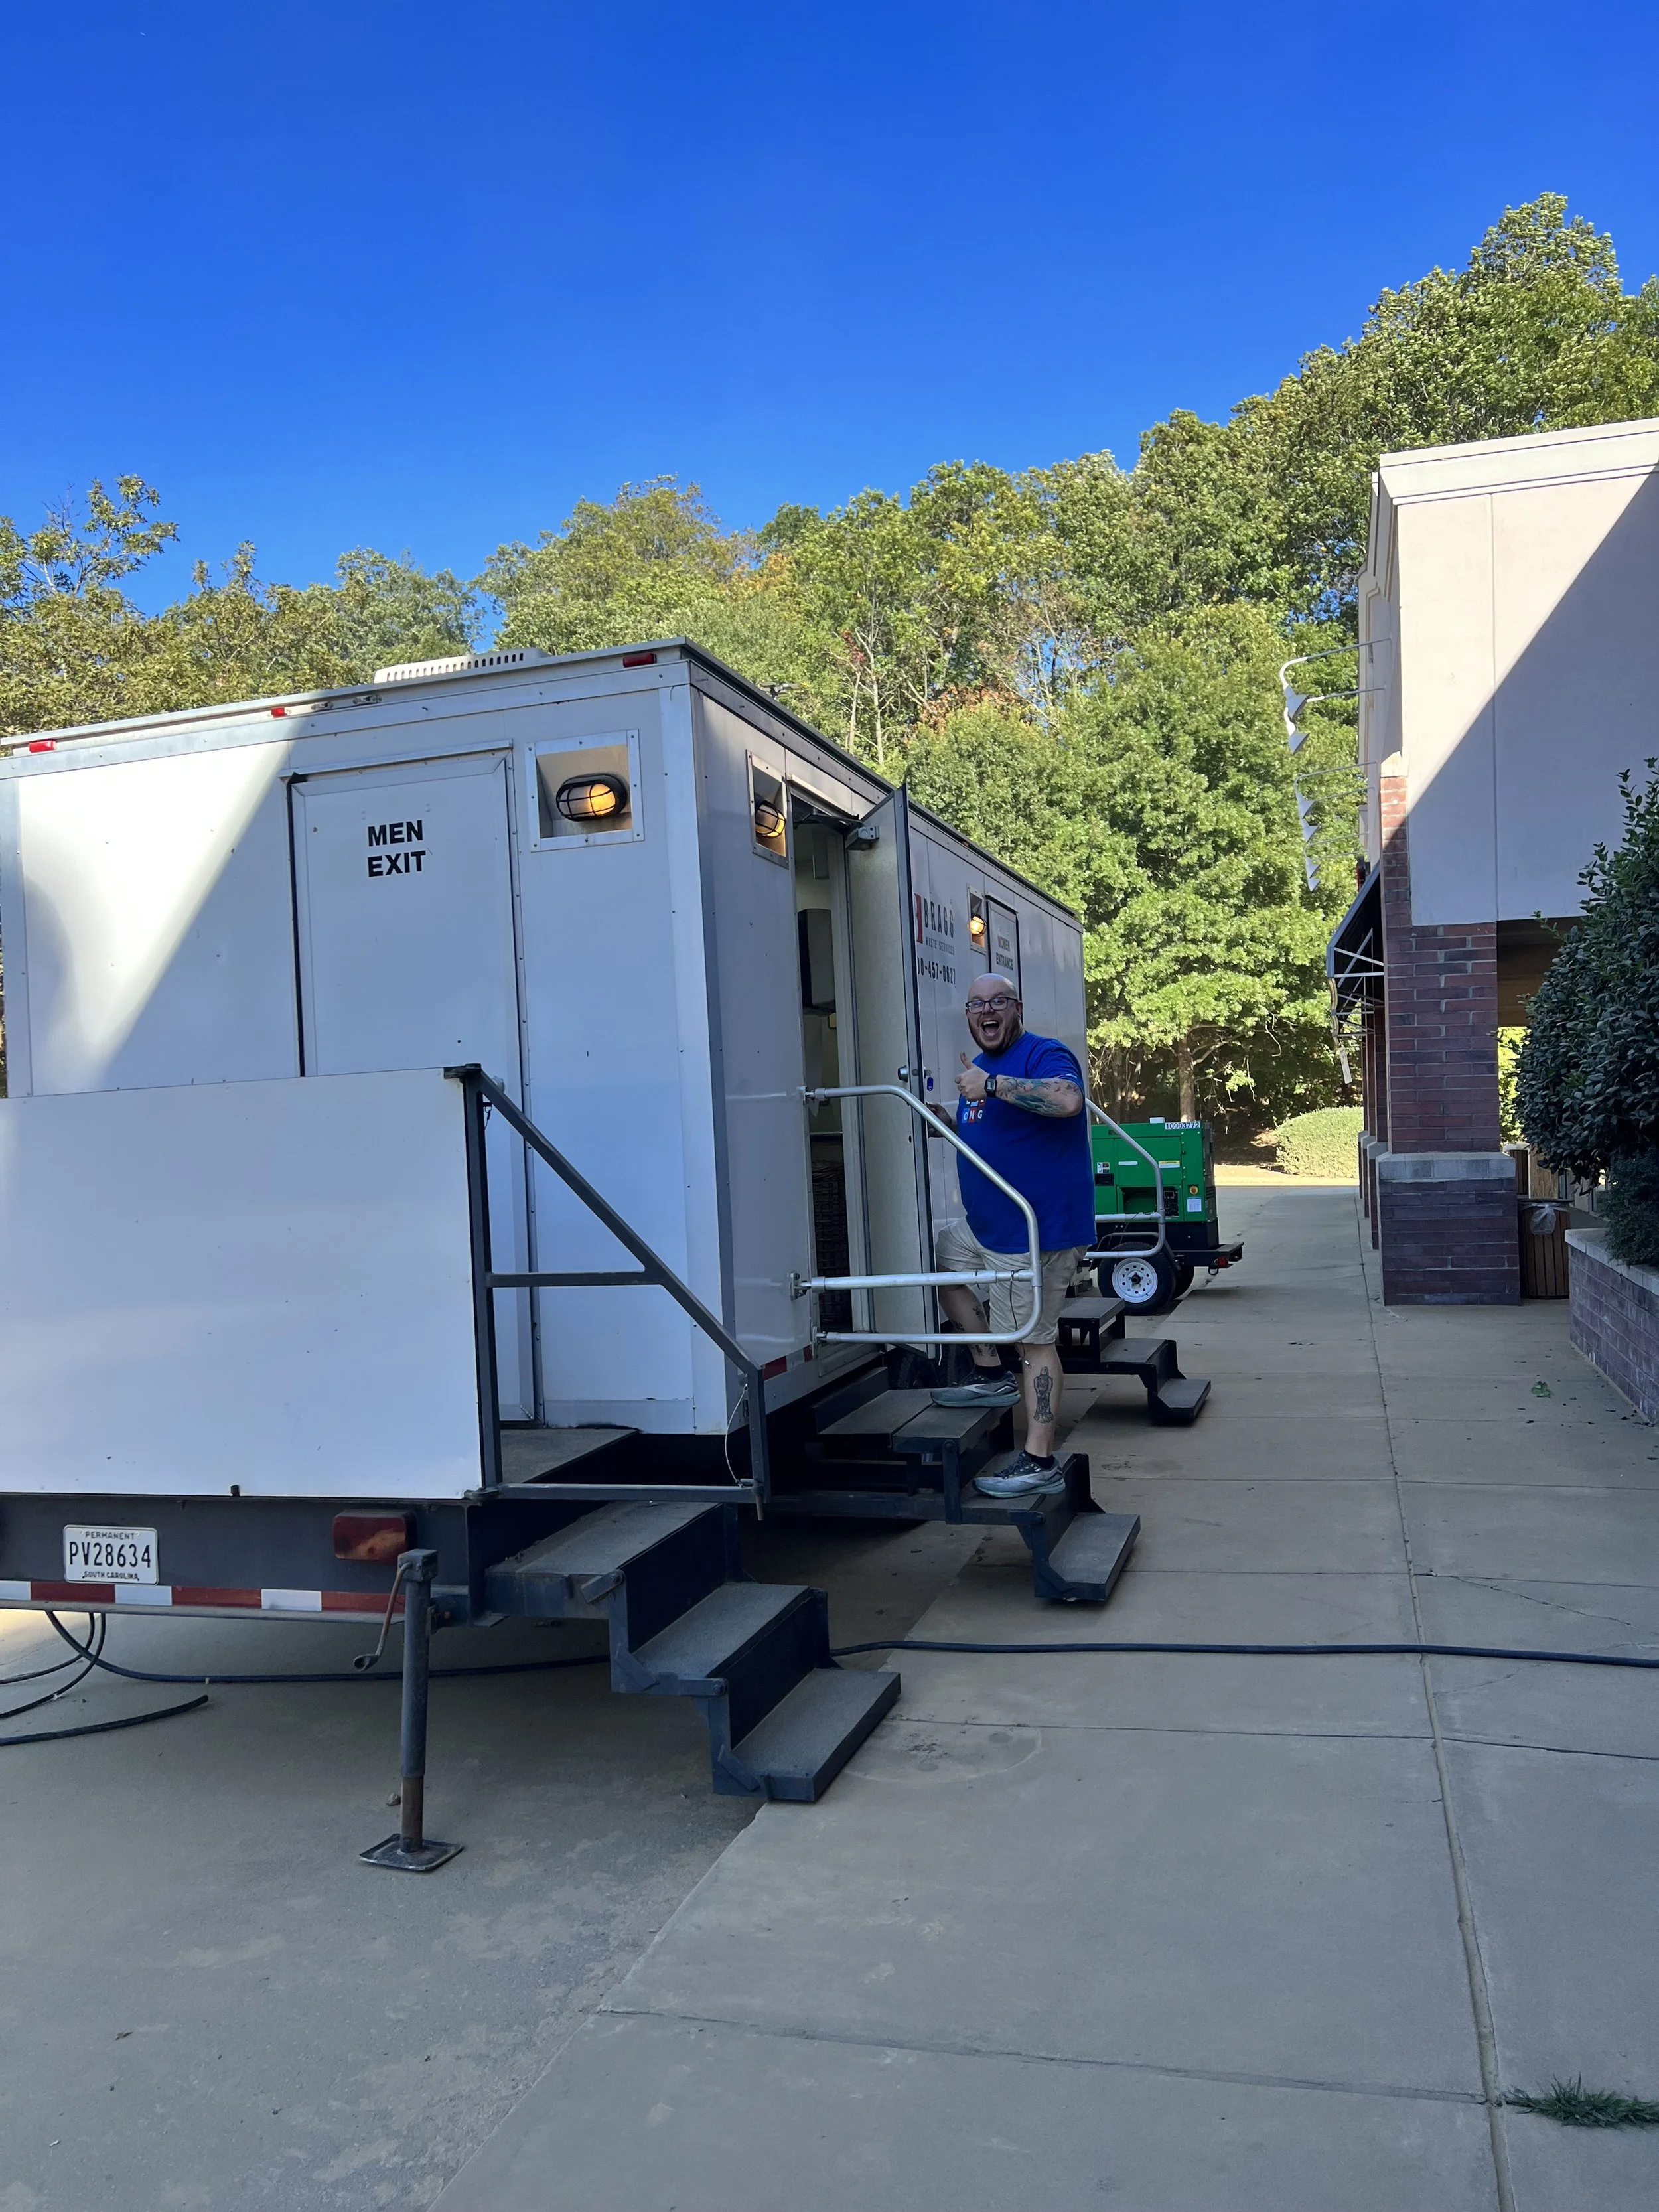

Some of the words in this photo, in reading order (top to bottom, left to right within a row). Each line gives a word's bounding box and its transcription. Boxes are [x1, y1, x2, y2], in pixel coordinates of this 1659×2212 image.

[368, 820, 423, 847] MEN
[368, 850, 426, 877] EXIT
[924, 897, 954, 938] BRAGG
[996, 952, 1014, 971] ENTRANCE
[85, 1531, 135, 1540] PERMANENT
[69, 1541, 151, 1568] PV28634
